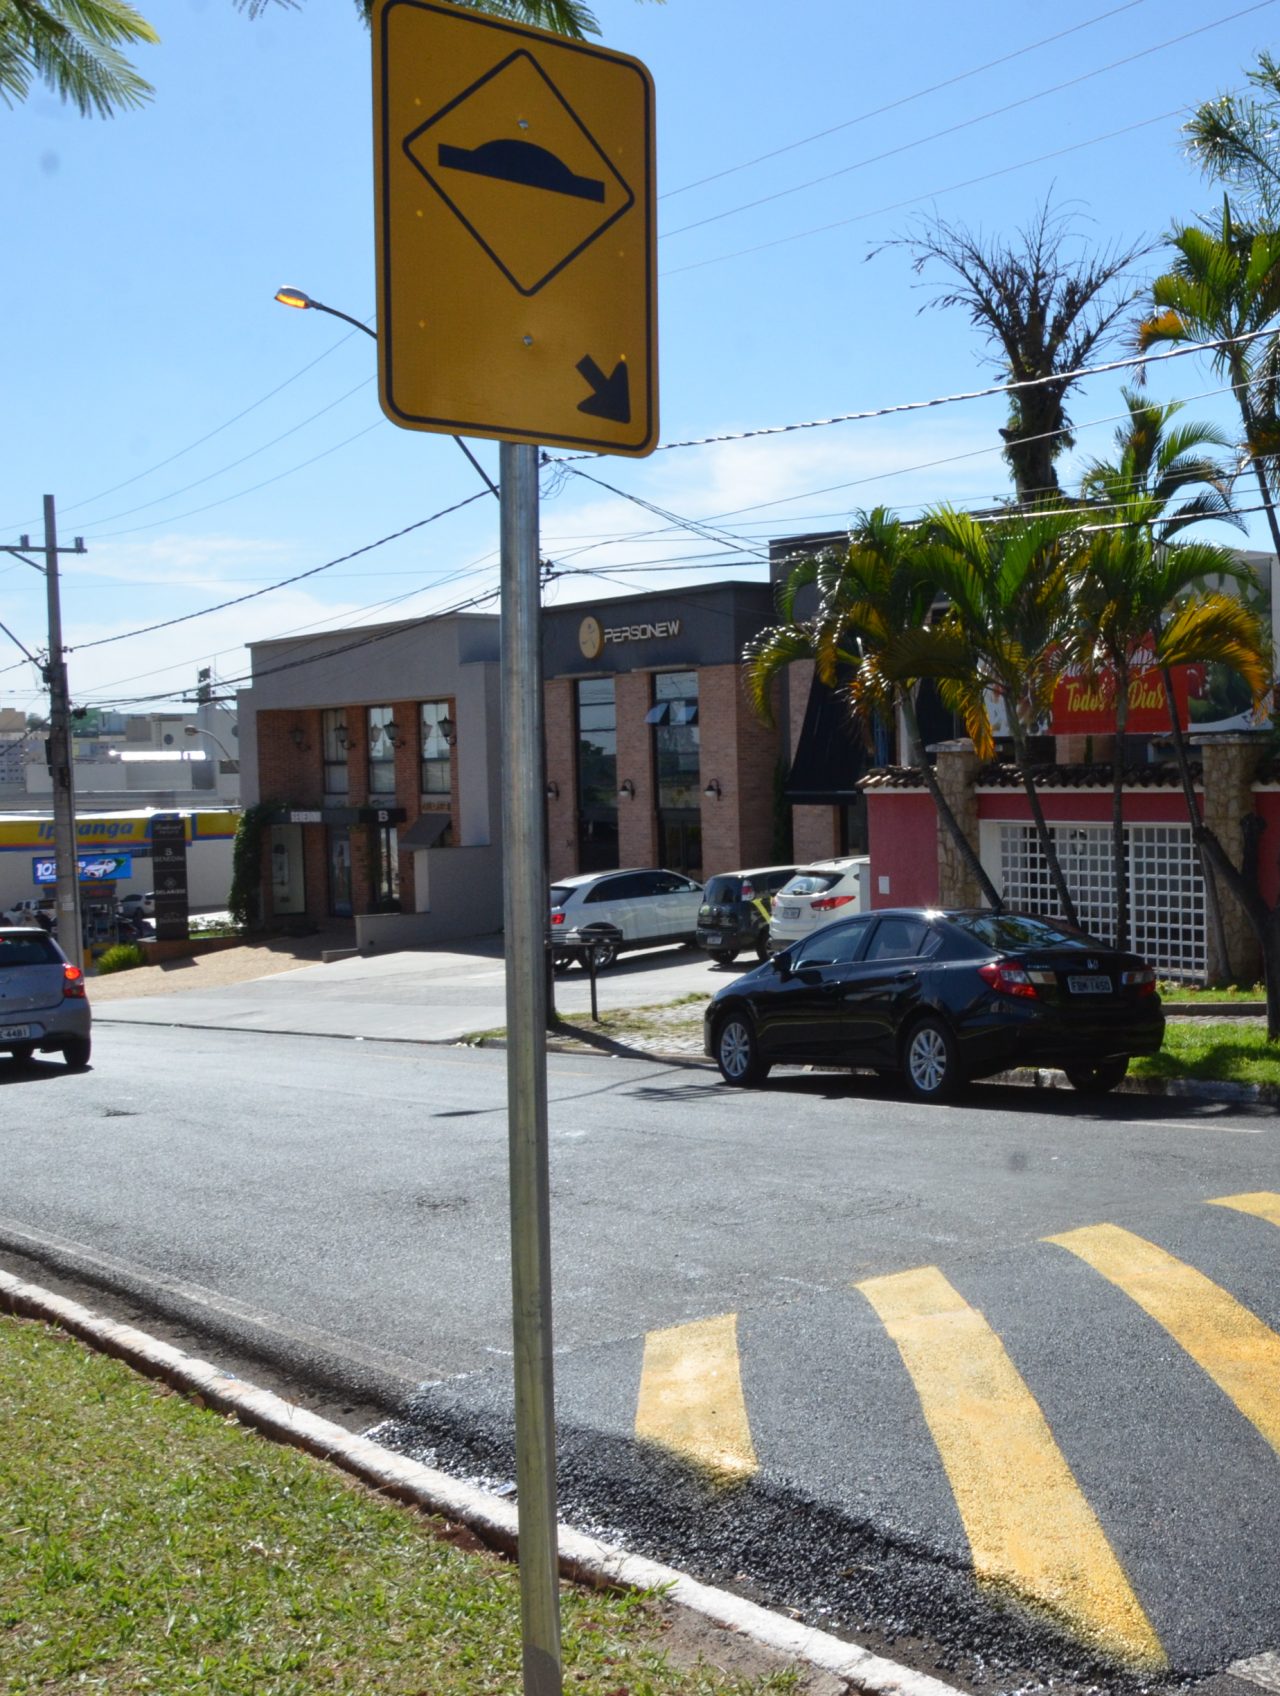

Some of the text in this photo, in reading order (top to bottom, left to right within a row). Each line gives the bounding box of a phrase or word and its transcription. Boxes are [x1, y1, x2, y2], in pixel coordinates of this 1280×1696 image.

[604, 619, 680, 643] PERSONEW
[1127, 679, 1166, 710] Dias
[378, 810, 389, 822] B
